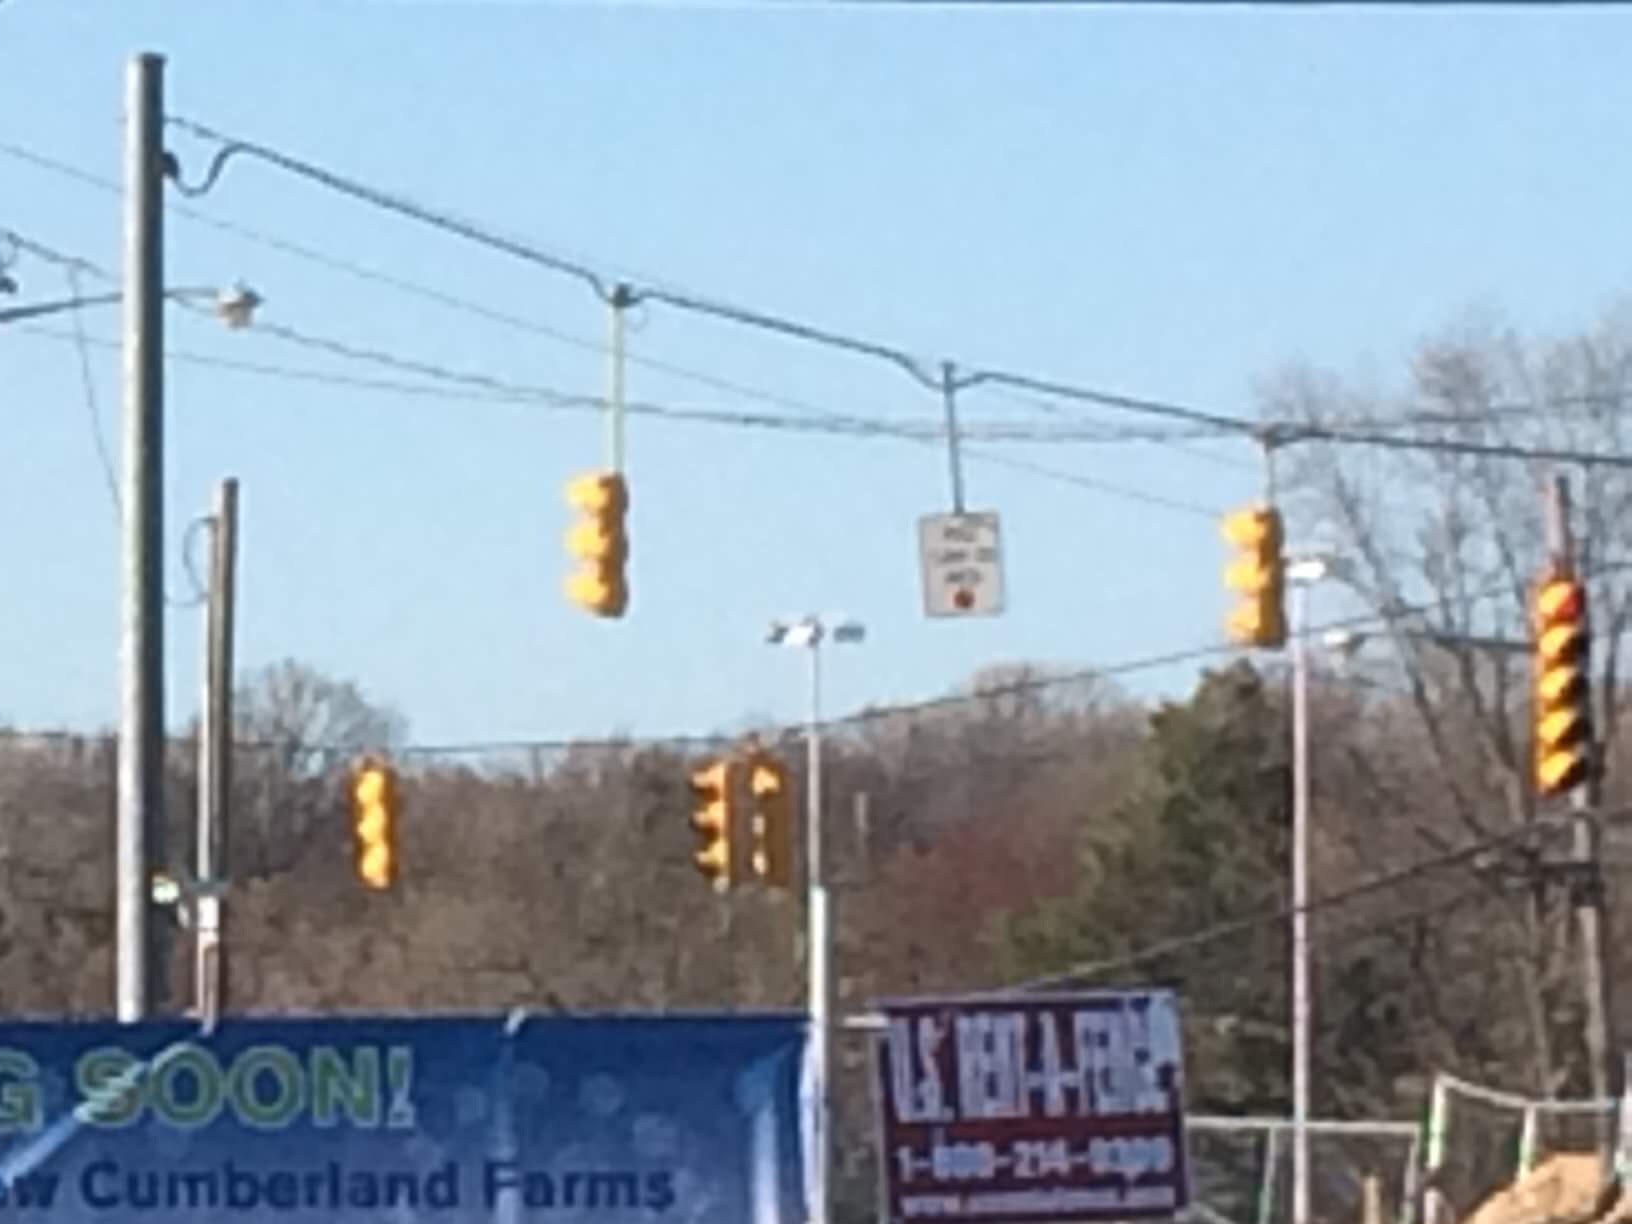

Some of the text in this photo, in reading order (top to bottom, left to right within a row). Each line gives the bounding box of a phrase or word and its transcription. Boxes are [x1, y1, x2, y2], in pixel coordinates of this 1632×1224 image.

[74, 1045, 416, 1131] SOON!
[78, 1160, 460, 1211] Cumberland
[483, 1160, 678, 1212] Farms
